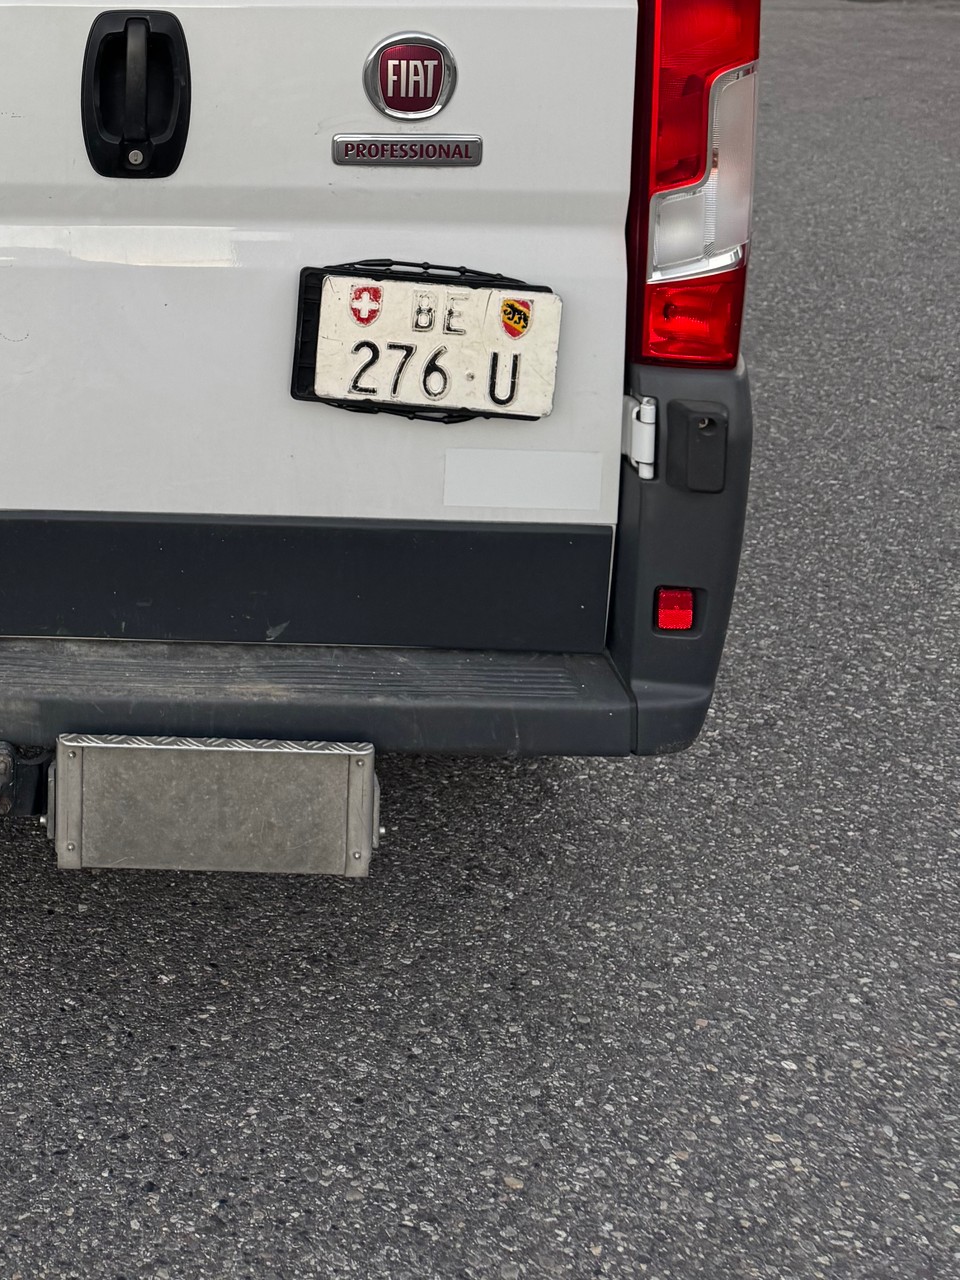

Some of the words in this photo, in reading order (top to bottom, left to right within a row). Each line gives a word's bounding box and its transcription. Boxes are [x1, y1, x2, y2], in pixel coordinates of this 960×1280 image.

[387, 59, 439, 98] FIAT
[344, 142, 473, 160] PROFESSIONAL
[411, 288, 471, 336] BE
